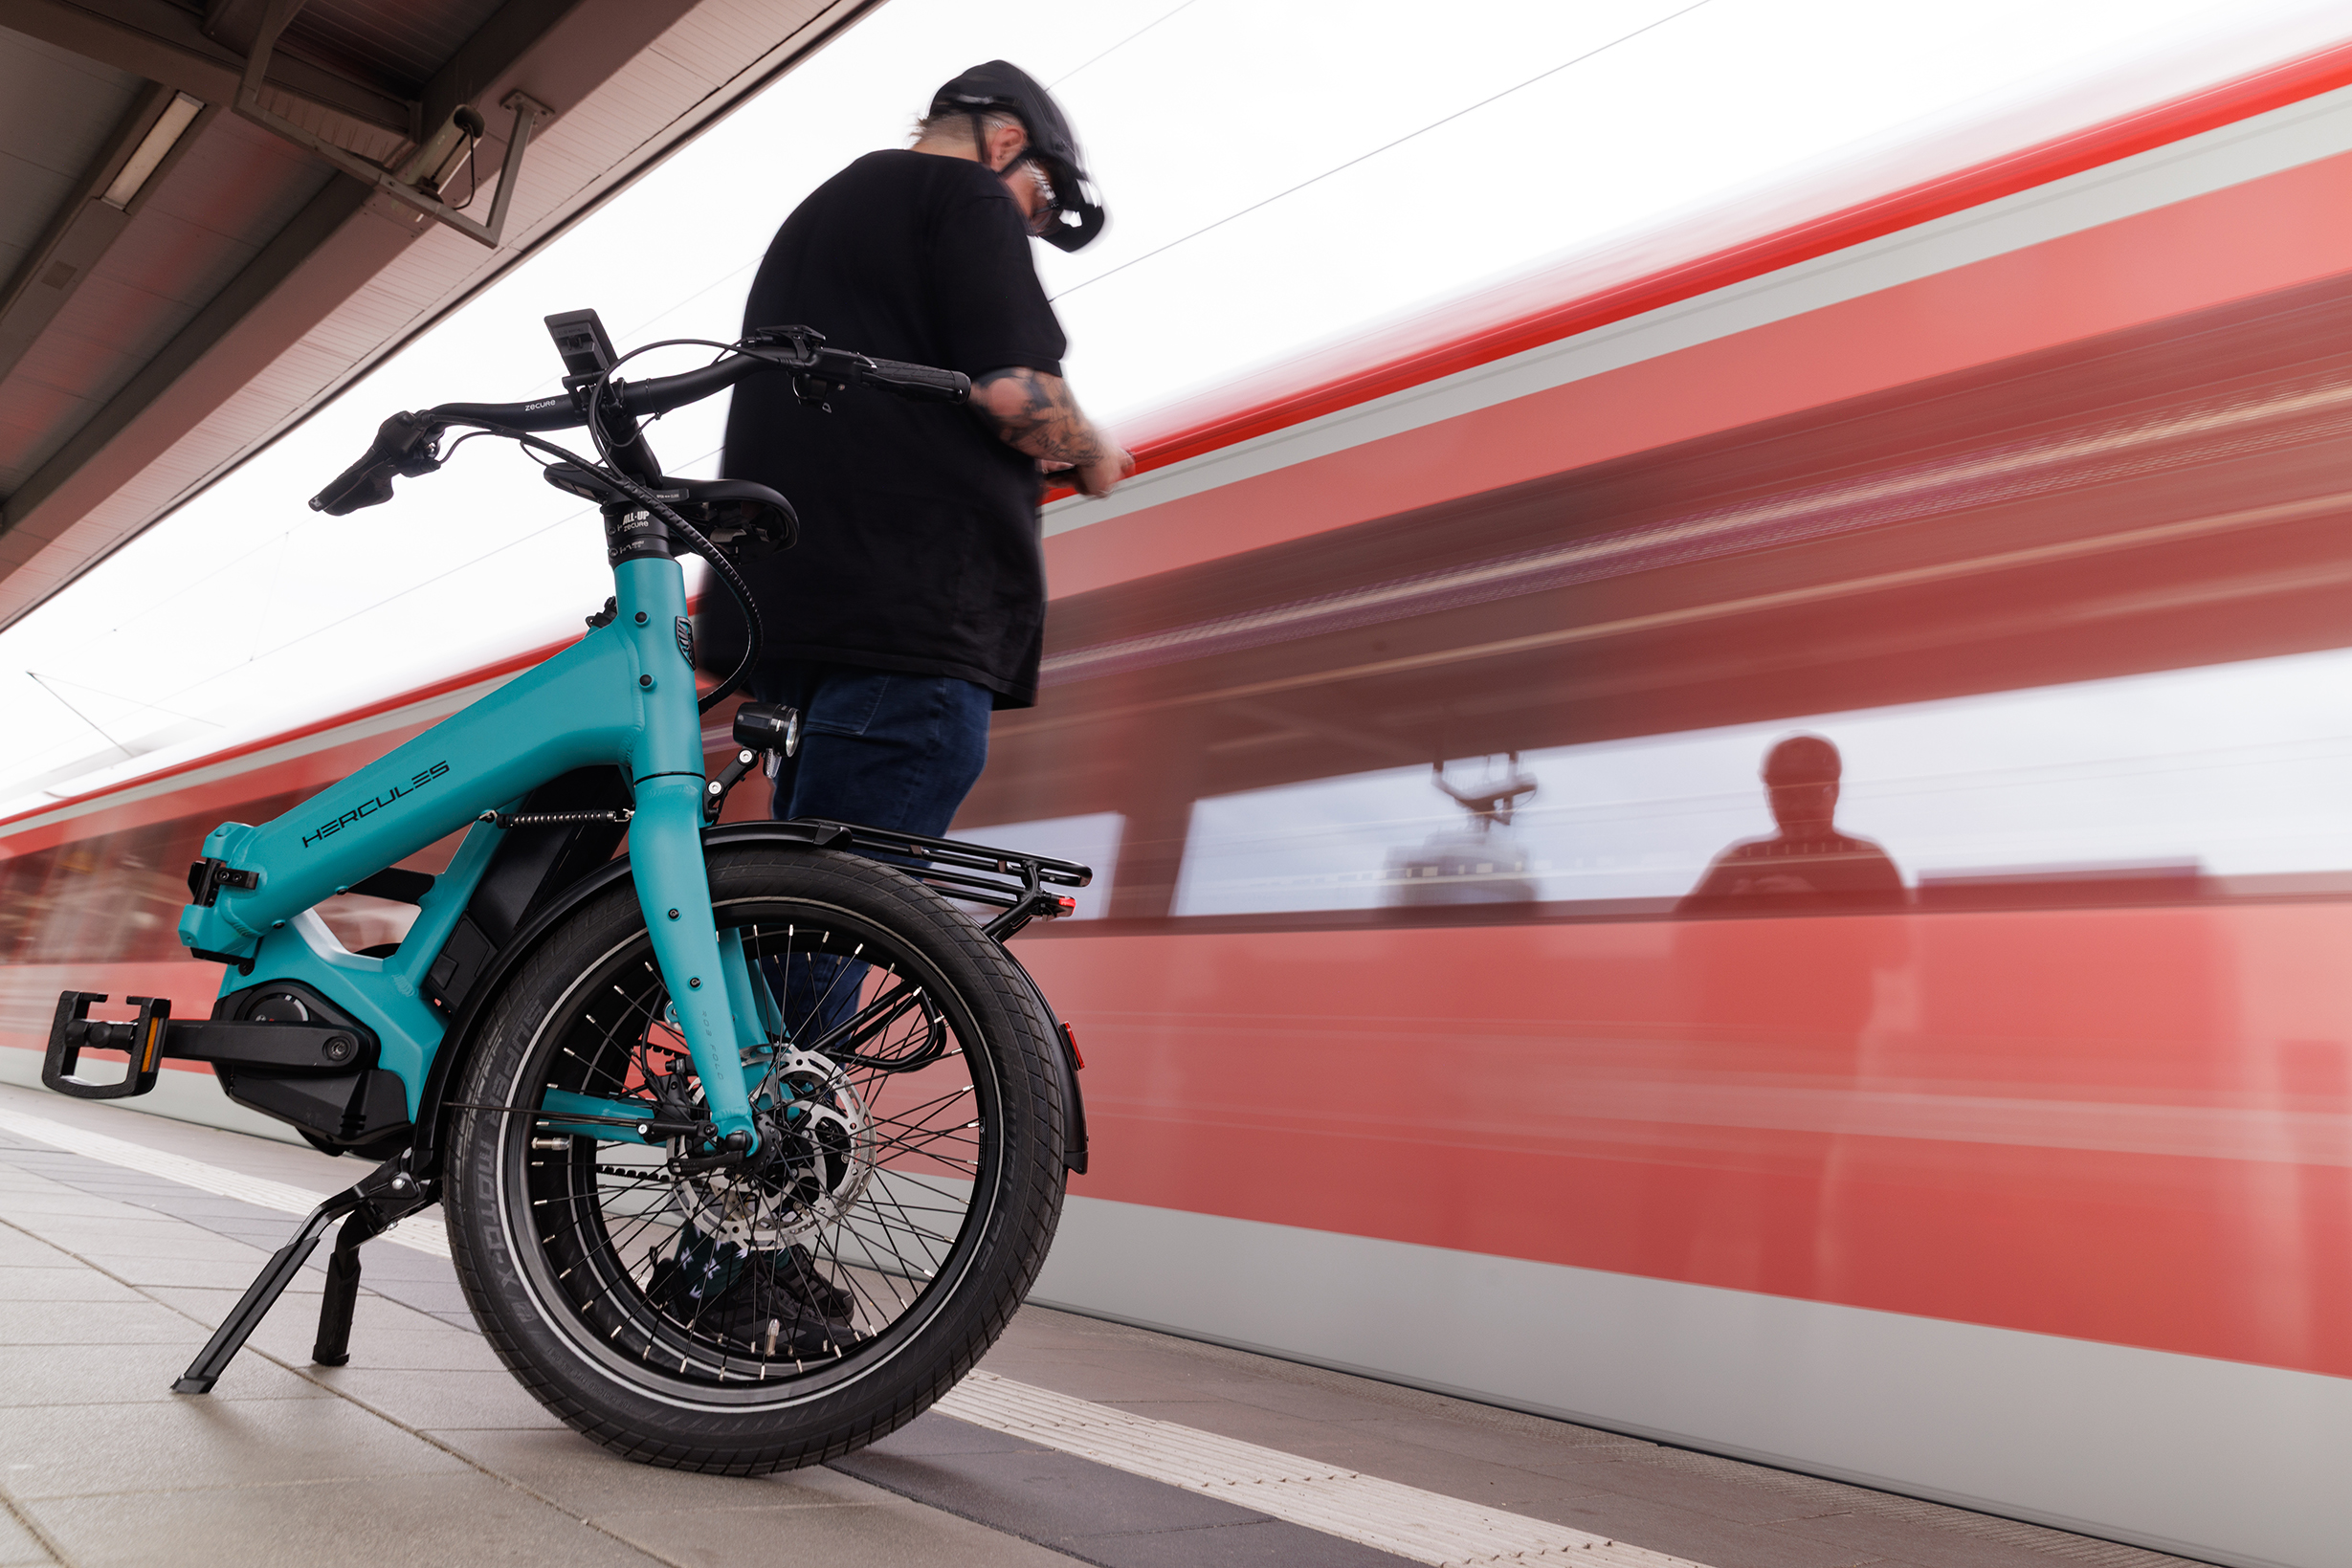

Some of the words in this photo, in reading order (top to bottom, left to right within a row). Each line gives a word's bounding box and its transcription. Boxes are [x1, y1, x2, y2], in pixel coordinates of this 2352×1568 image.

[302, 761, 450, 849] HERCULES
[701, 1010, 712, 1037] ROB
[710, 1044, 723, 1080] FOLD
